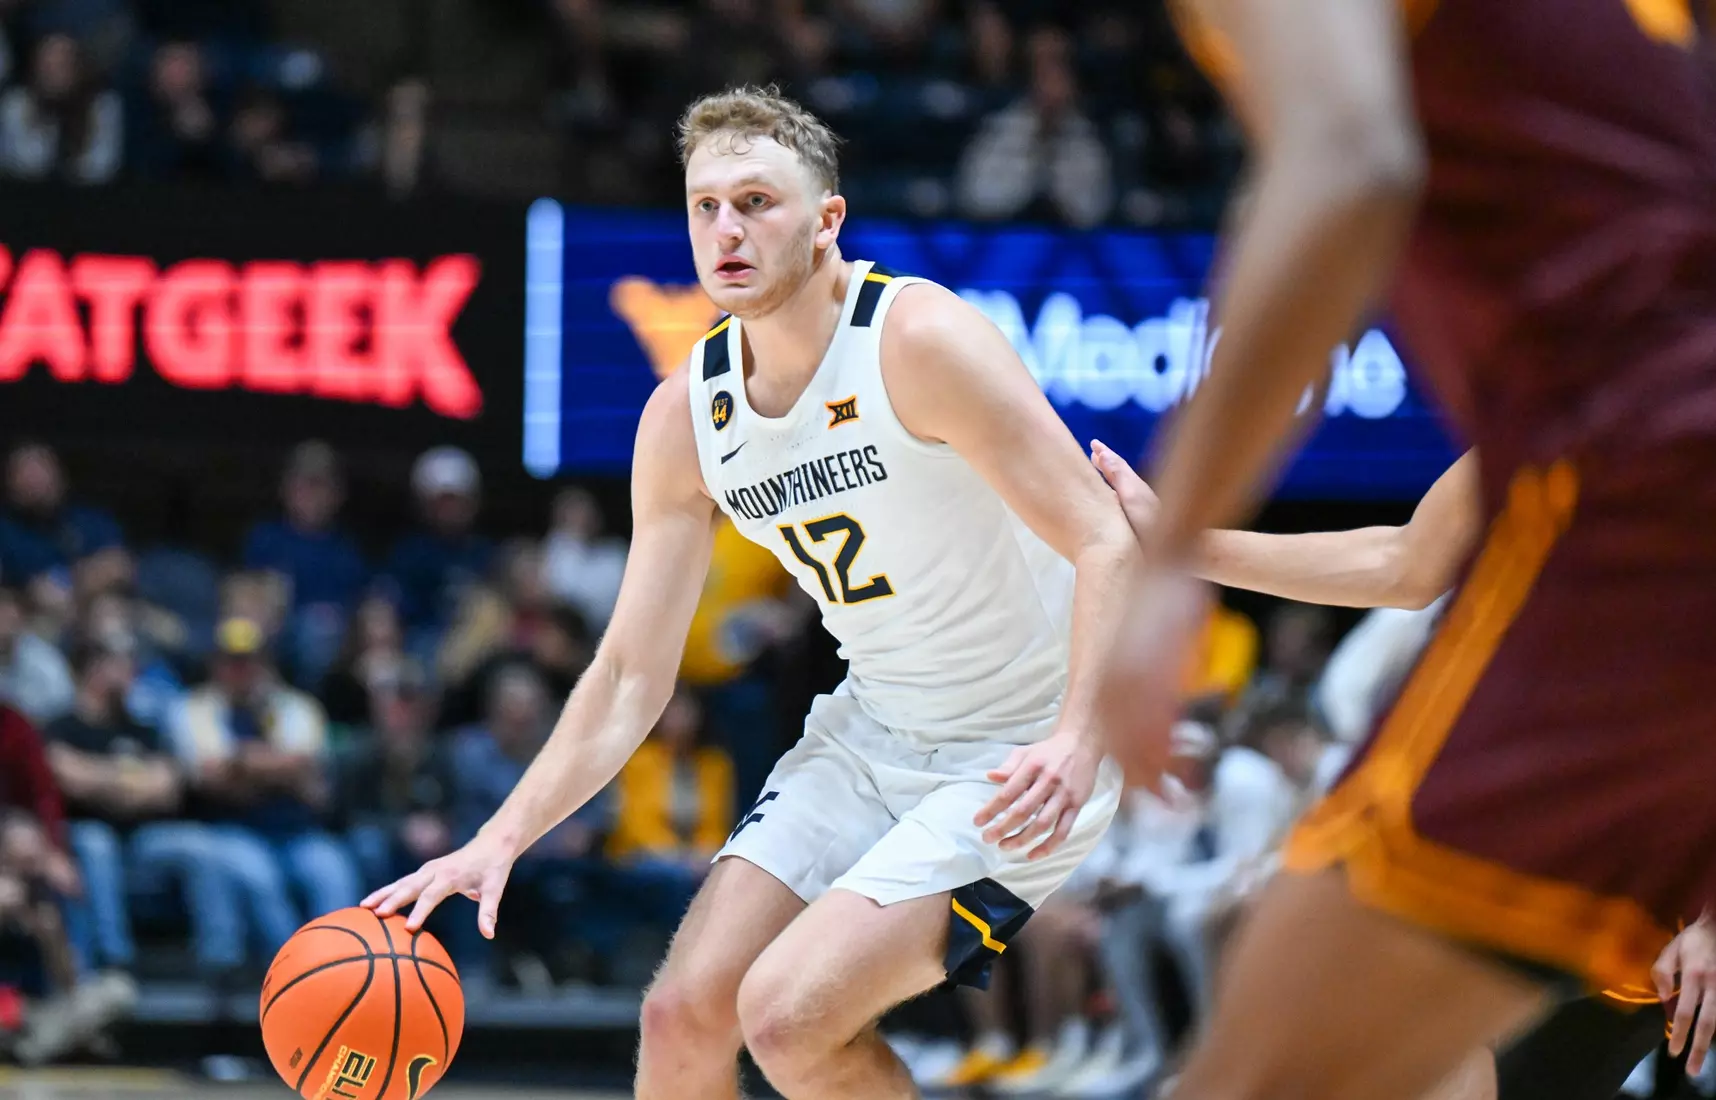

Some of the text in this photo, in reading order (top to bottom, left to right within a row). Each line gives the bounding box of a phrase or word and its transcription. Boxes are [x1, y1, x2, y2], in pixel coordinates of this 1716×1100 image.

[0, 245, 482, 419] ATGEEK
[713, 405, 727, 423] 44
[724, 444, 888, 521] MOUNTAINEERS
[776, 511, 897, 606] 12
[325, 1048, 377, 1100] ELI
